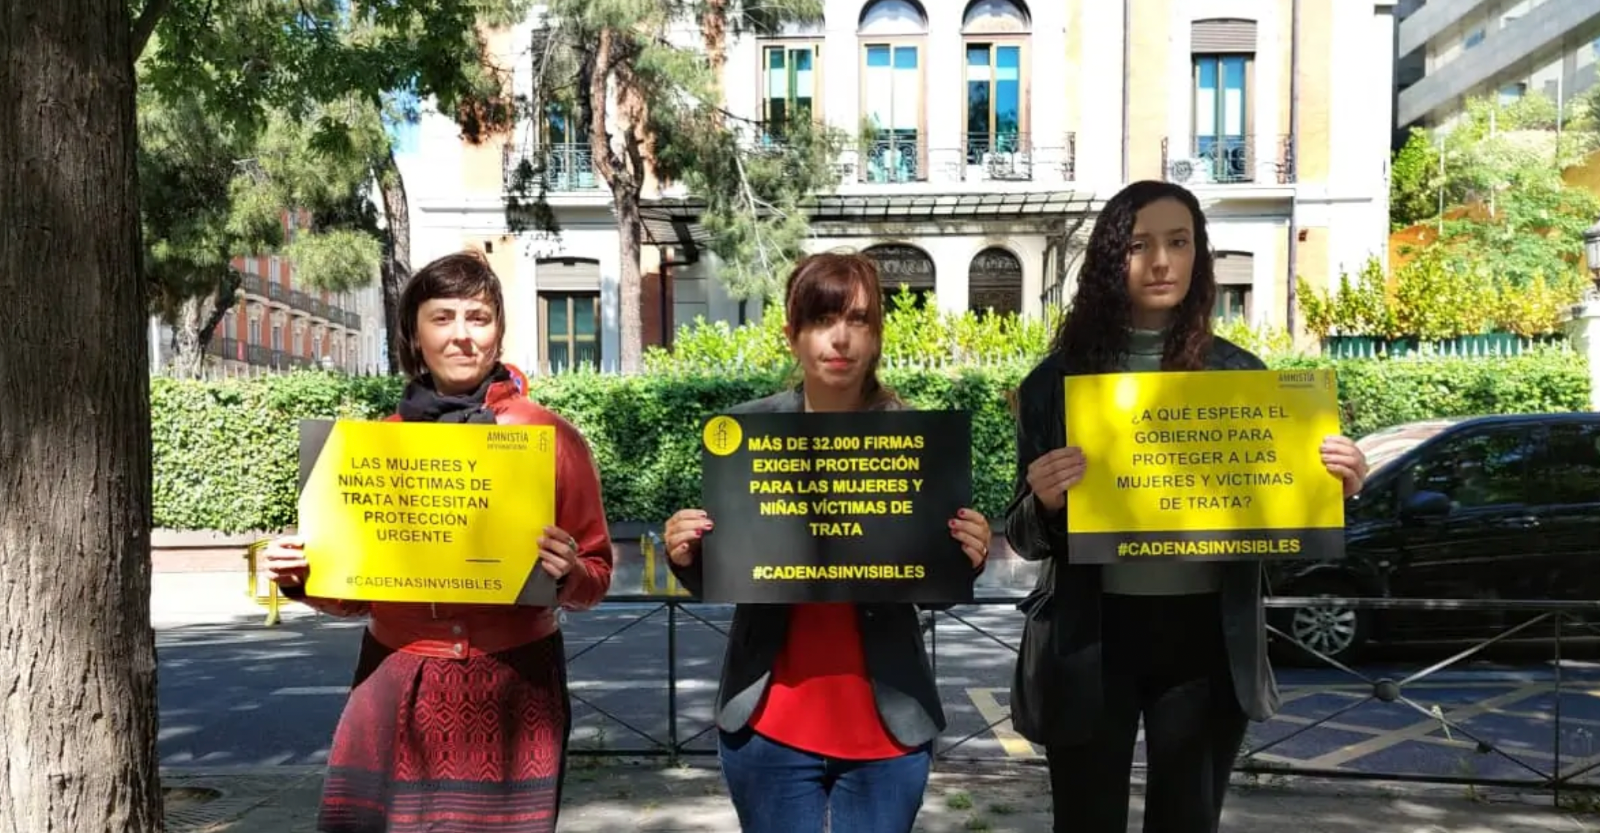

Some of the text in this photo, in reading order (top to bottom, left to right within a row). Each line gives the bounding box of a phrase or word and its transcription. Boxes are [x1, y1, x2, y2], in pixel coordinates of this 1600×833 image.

[1132, 405, 1288, 424] ¿A QUÉ ESPERA EL
[749, 435, 924, 450] MÁS DE 32.000 FIRMAS
[1135, 429, 1272, 444] GOBIERNO PARA
[352, 458, 477, 471] LAS MUJERES Y
[753, 455, 919, 472] EXIGEN PROTECCIÓN
[1133, 450, 1276, 466] PROTEGER A LAS
[339, 473, 491, 491] NIÑAS VÍCTIMAS DE
[750, 479, 923, 493] PARA LAS MUJERES Y
[1117, 472, 1293, 488] MUJERES Y VÍCTIMAS
[342, 493, 488, 508] TRATA NECESITAN
[760, 499, 912, 515] NIÑAS VÍCTIMAS DE
[1160, 496, 1252, 510] DE TRATA?
[364, 511, 467, 526] PROTECCIÓN
[378, 530, 452, 543] URGENTE
[810, 523, 862, 535] TRATA
[1118, 539, 1299, 556] #CADENASINVISIBLES
[753, 566, 925, 580] #CADENASINVISIBLES
[346, 576, 502, 590] #CADENASINVISIBLES
